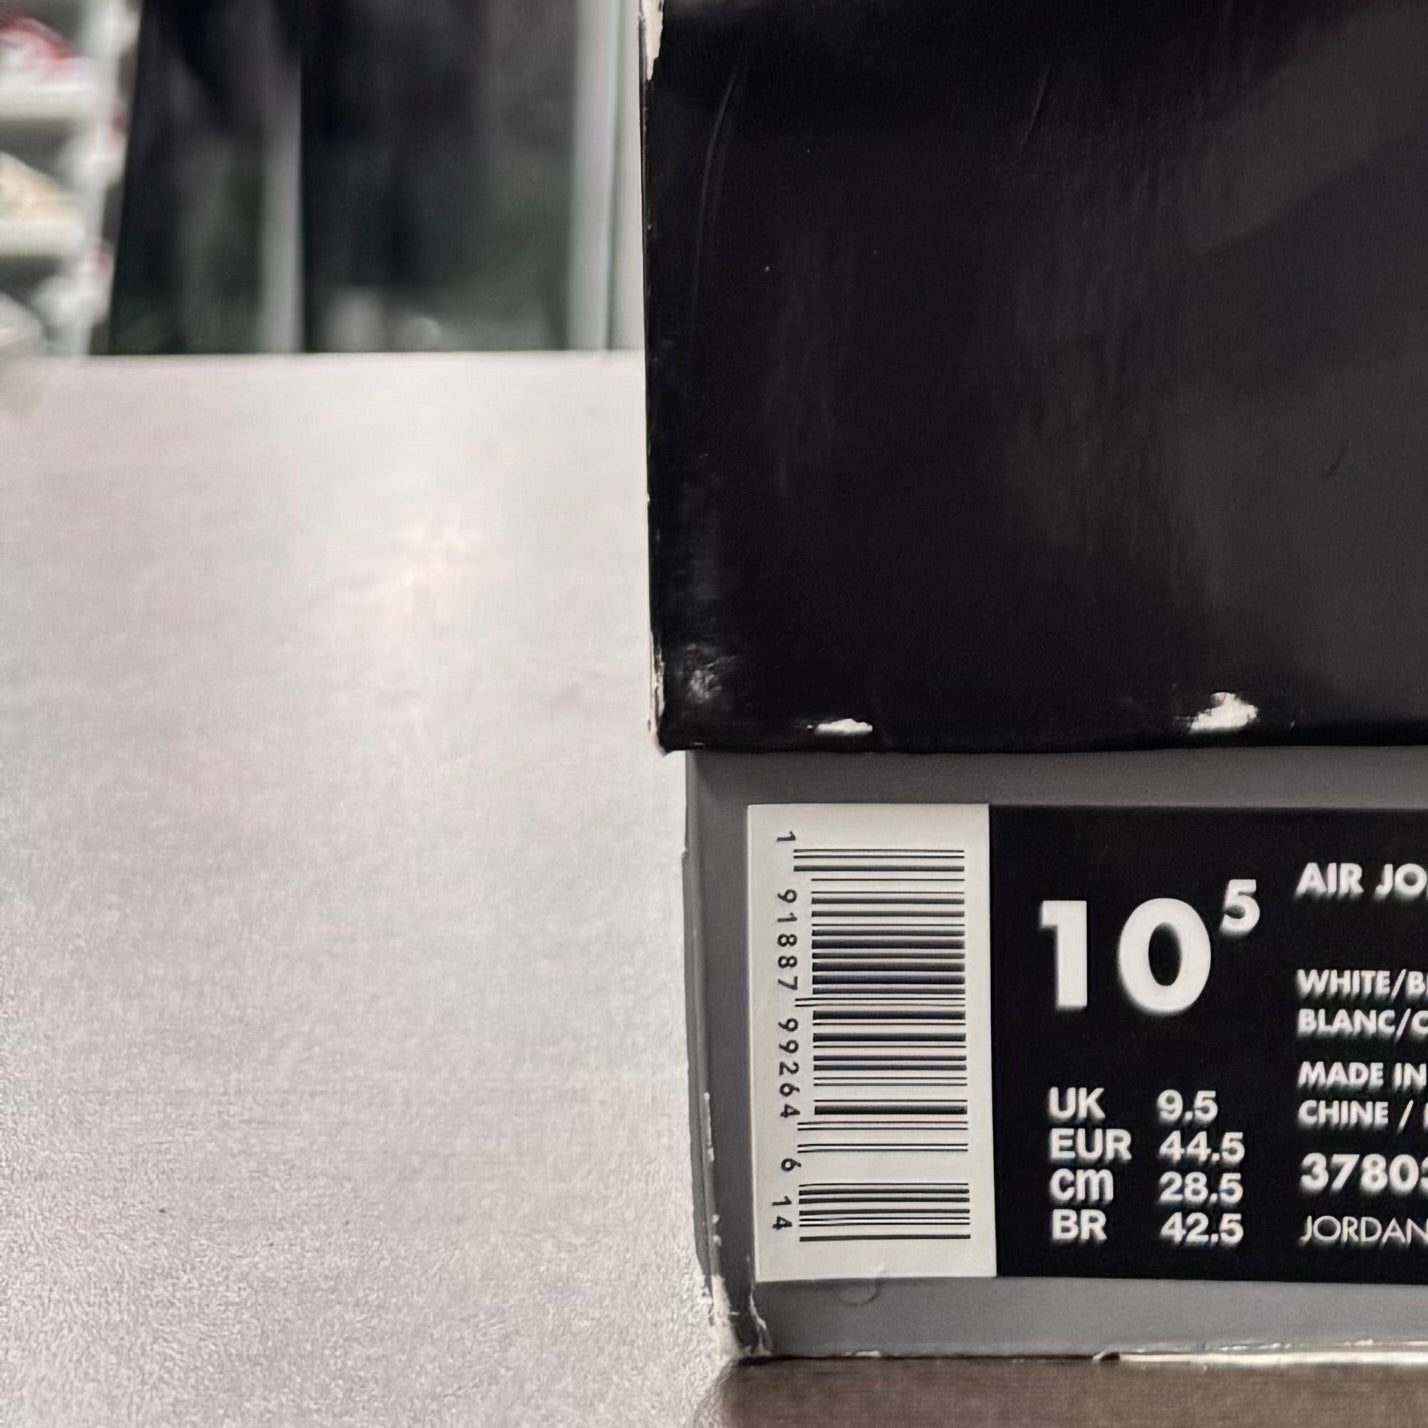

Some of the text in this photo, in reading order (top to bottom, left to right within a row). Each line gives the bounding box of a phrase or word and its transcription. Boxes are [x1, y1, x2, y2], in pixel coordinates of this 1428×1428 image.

[1295, 862, 1364, 897] AIR
[776, 889, 798, 991] 91887
[777, 1018, 801, 1119] 99264
[1297, 1061, 1384, 1089] MADE
[1393, 1062, 1427, 1090] IN
[1048, 1086, 1219, 1124] UK 9.5
[1297, 1099, 1389, 1127] CHINE
[1049, 1127, 1246, 1165] EUR 44.5
[1049, 1168, 1244, 1205] cm 28.5
[1051, 1208, 1244, 1246] BR 42.5
